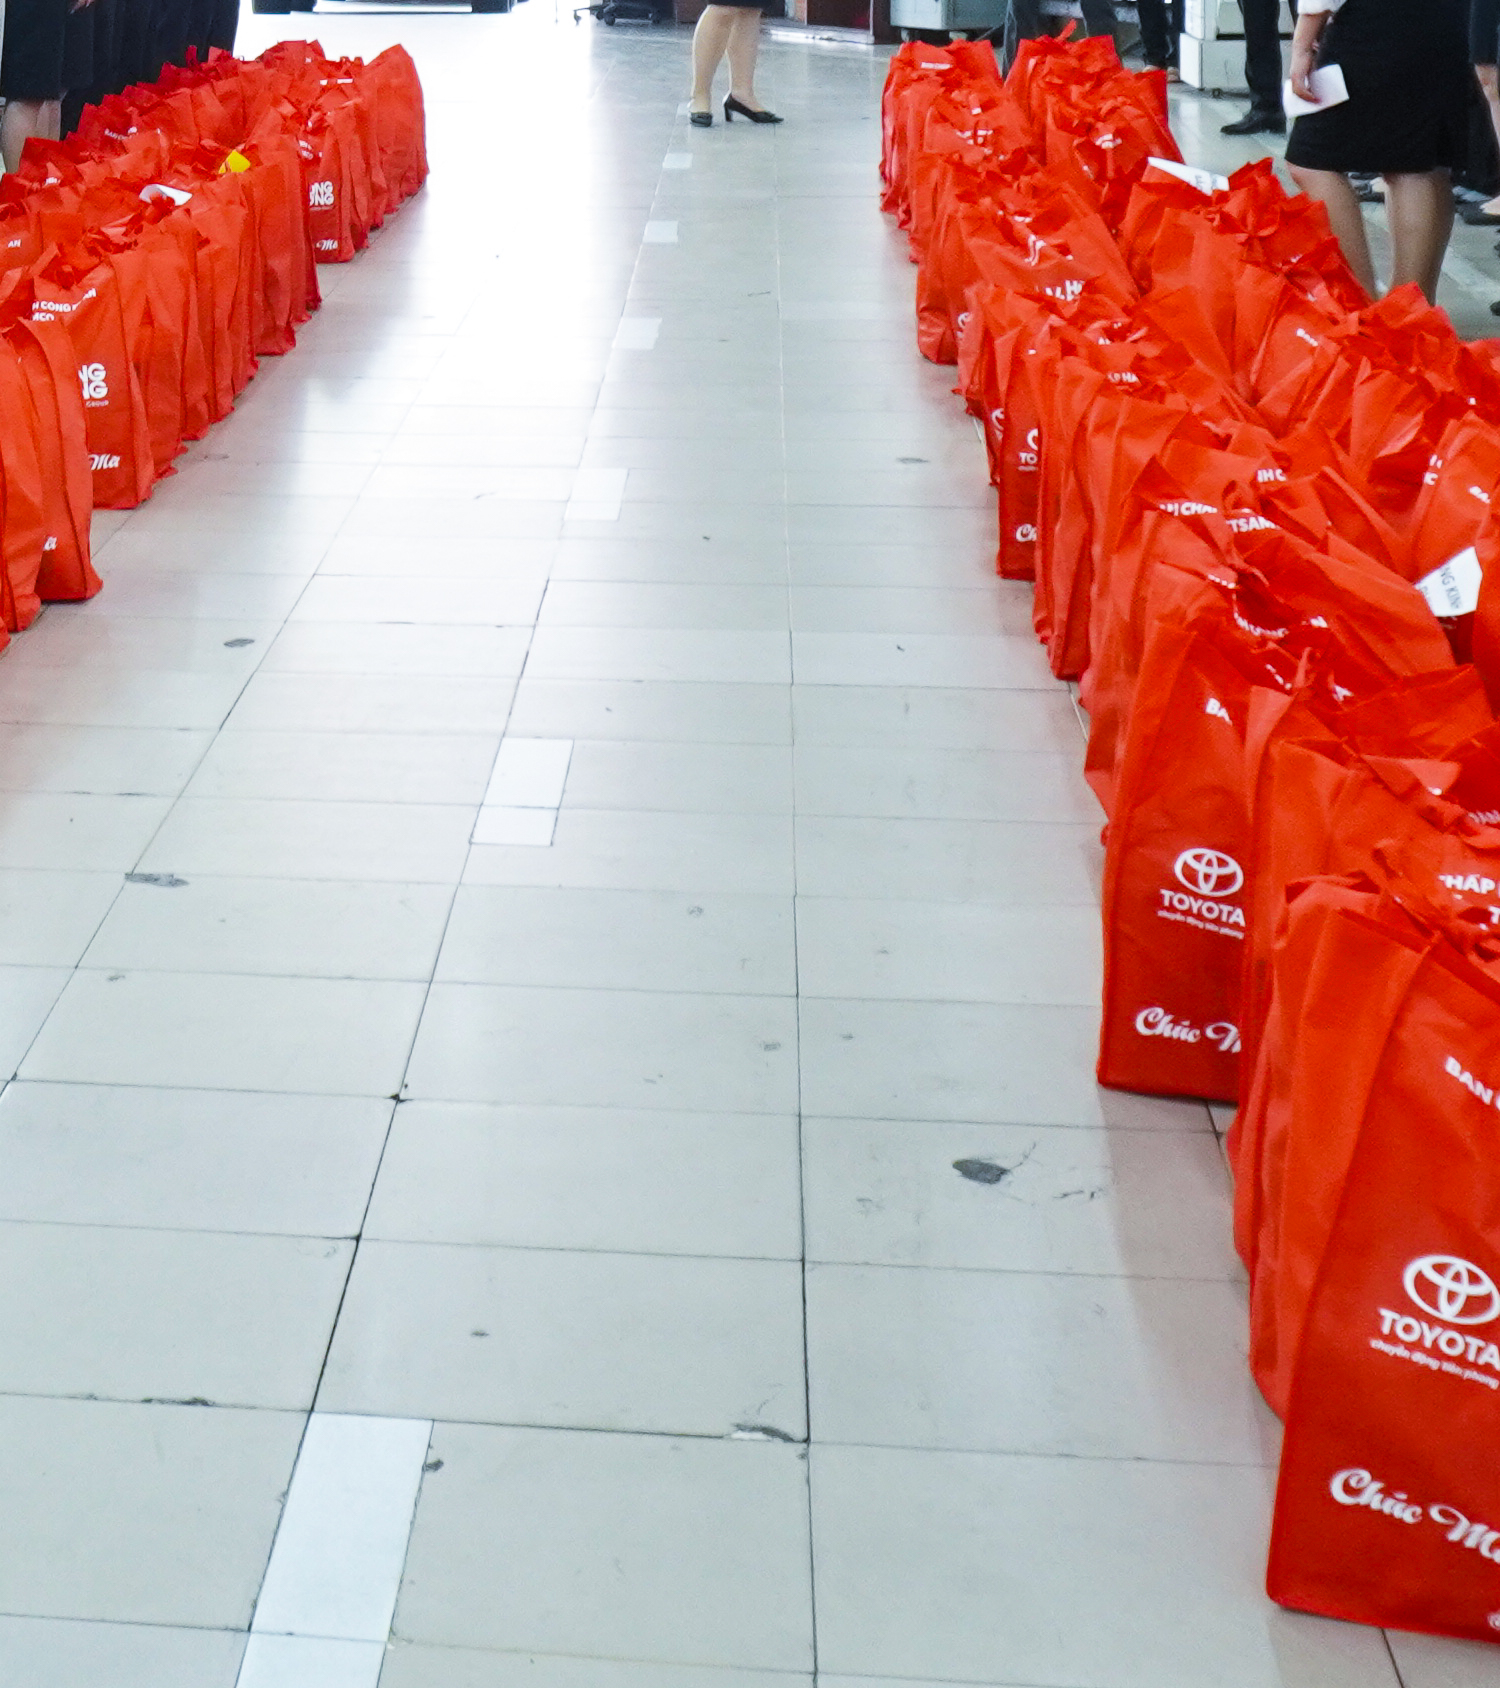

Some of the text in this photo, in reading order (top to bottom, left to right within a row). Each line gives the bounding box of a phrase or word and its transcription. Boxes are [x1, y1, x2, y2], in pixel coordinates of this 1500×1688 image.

[1160, 888, 1246, 928] TOYOTA
[1135, 1007, 1201, 1044] Chúc
[1445, 1055, 1494, 1105] BAN
[1328, 1467, 1423, 1525] Chúc
